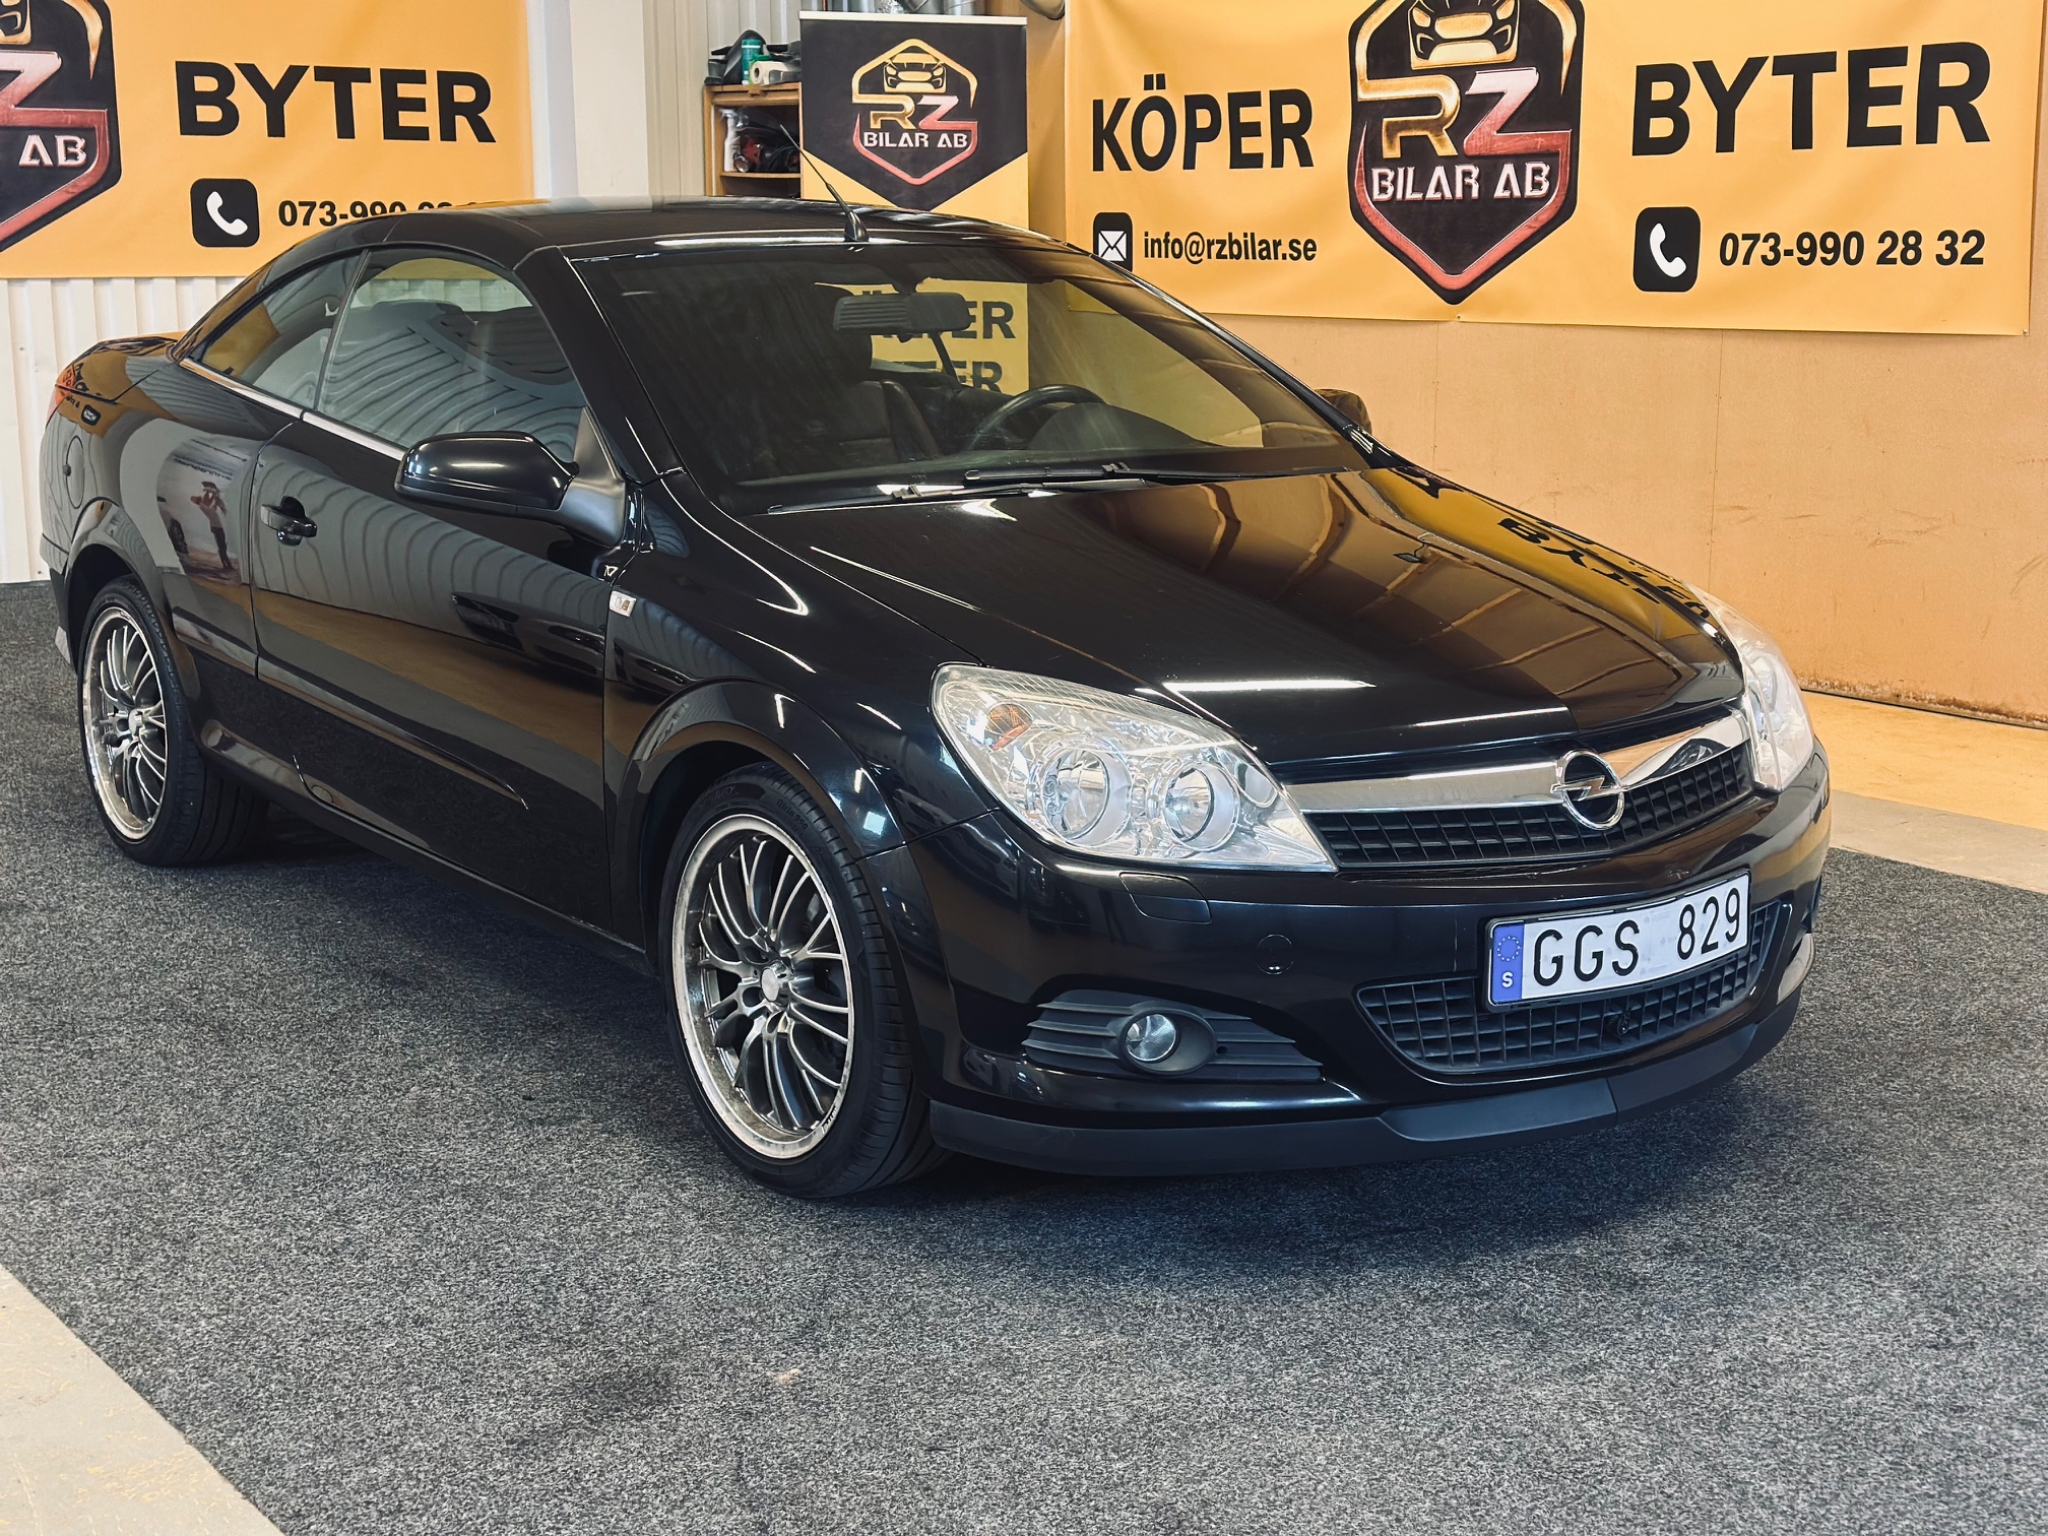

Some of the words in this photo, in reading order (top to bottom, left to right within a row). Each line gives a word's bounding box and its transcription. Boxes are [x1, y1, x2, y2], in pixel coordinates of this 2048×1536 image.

[175, 61, 496, 143] BYTER
[853, 94, 977, 131] RZ
[1357, 67, 1572, 159] RZ
[1632, 41, 1991, 157] BYTER
[863, 132, 929, 148] BILAR
[937, 132, 968, 148] AB
[1092, 73, 1314, 172] KÖPER
[19, 134, 87, 167] AB
[1371, 163, 1479, 202] BILAR
[1493, 161, 1551, 199] AB
[1144, 231, 1318, 264] info@rzbilar.se
[1720, 231, 1864, 266] 073-990
[1877, 231, 1922, 266] 28
[1936, 229, 1985, 265] 32
[1533, 919, 1640, 987] GGS
[1677, 887, 1741, 960] 829
[1502, 971, 1513, 987] S
